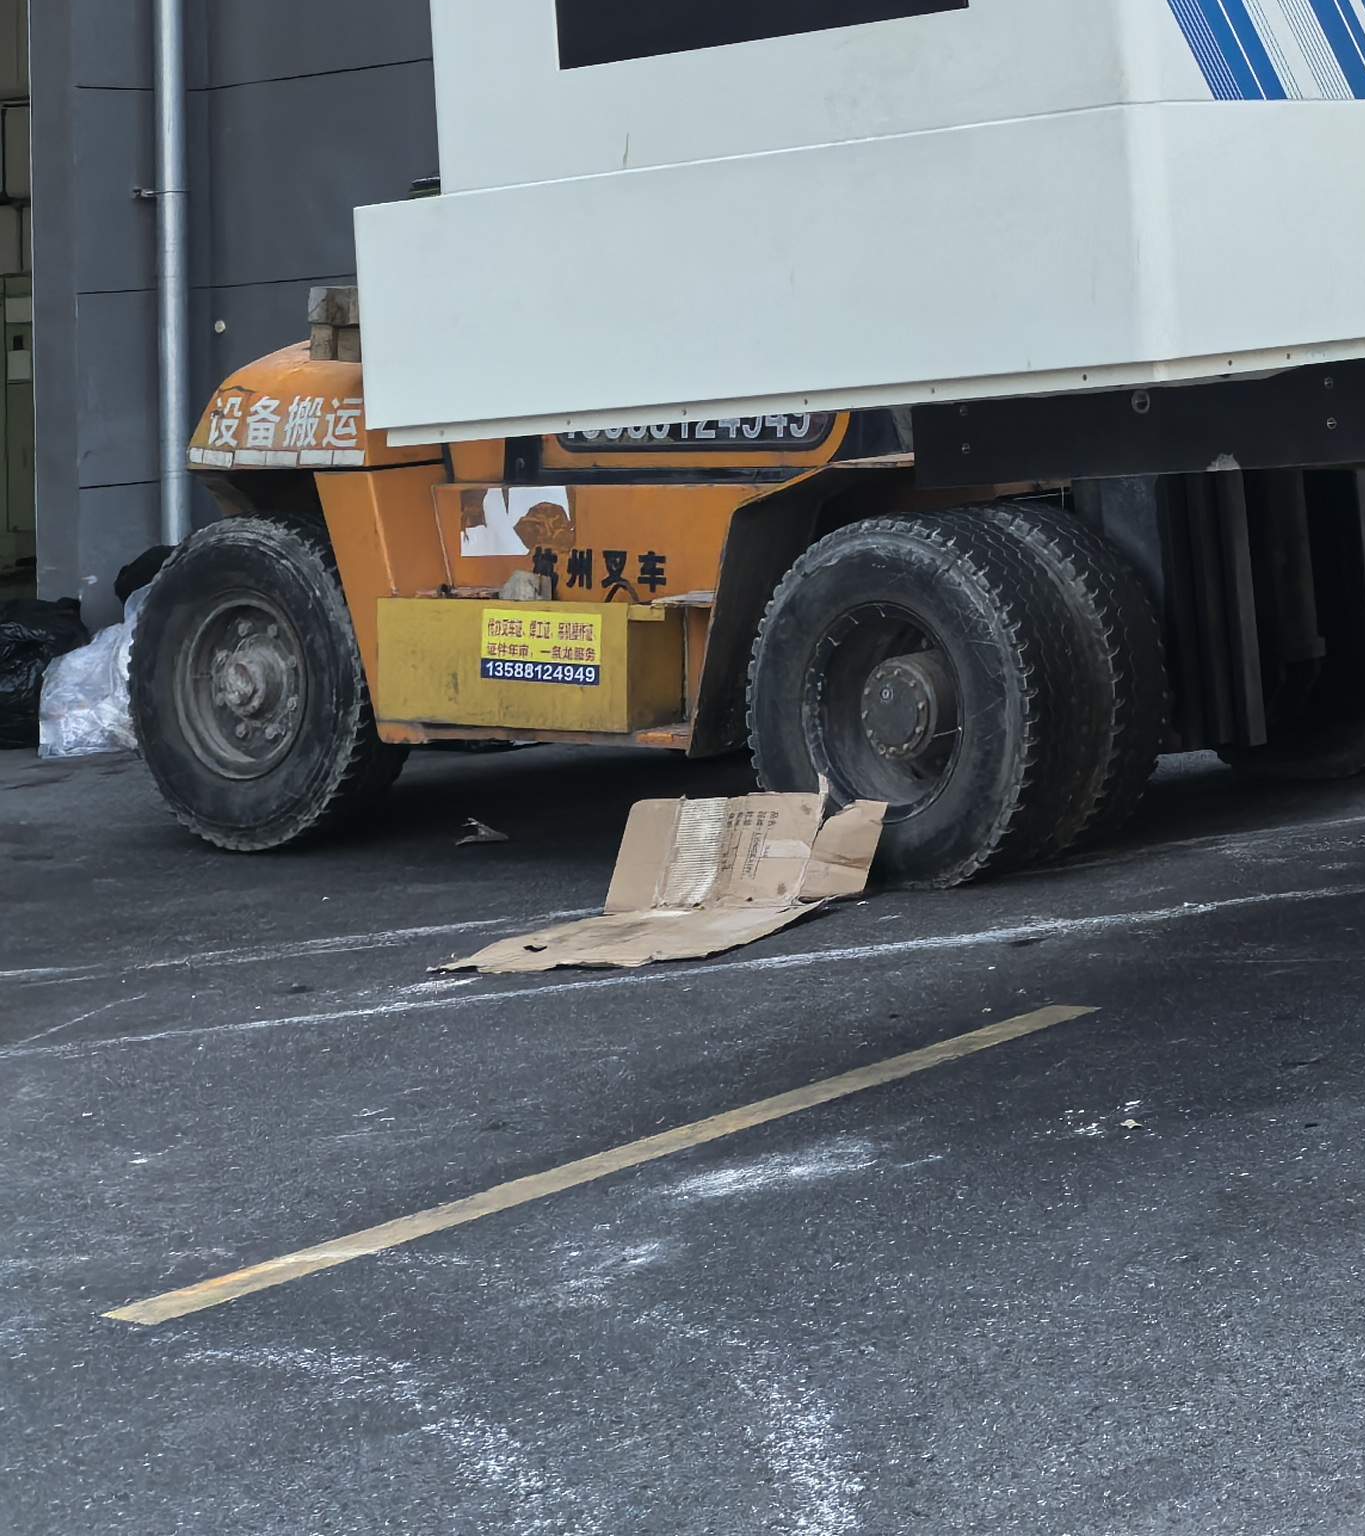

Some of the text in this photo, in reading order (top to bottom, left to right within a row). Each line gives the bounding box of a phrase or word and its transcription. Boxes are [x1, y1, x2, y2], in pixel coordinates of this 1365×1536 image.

[208, 395, 363, 448] 设备搬运
[486, 661, 595, 682] 13588124949
